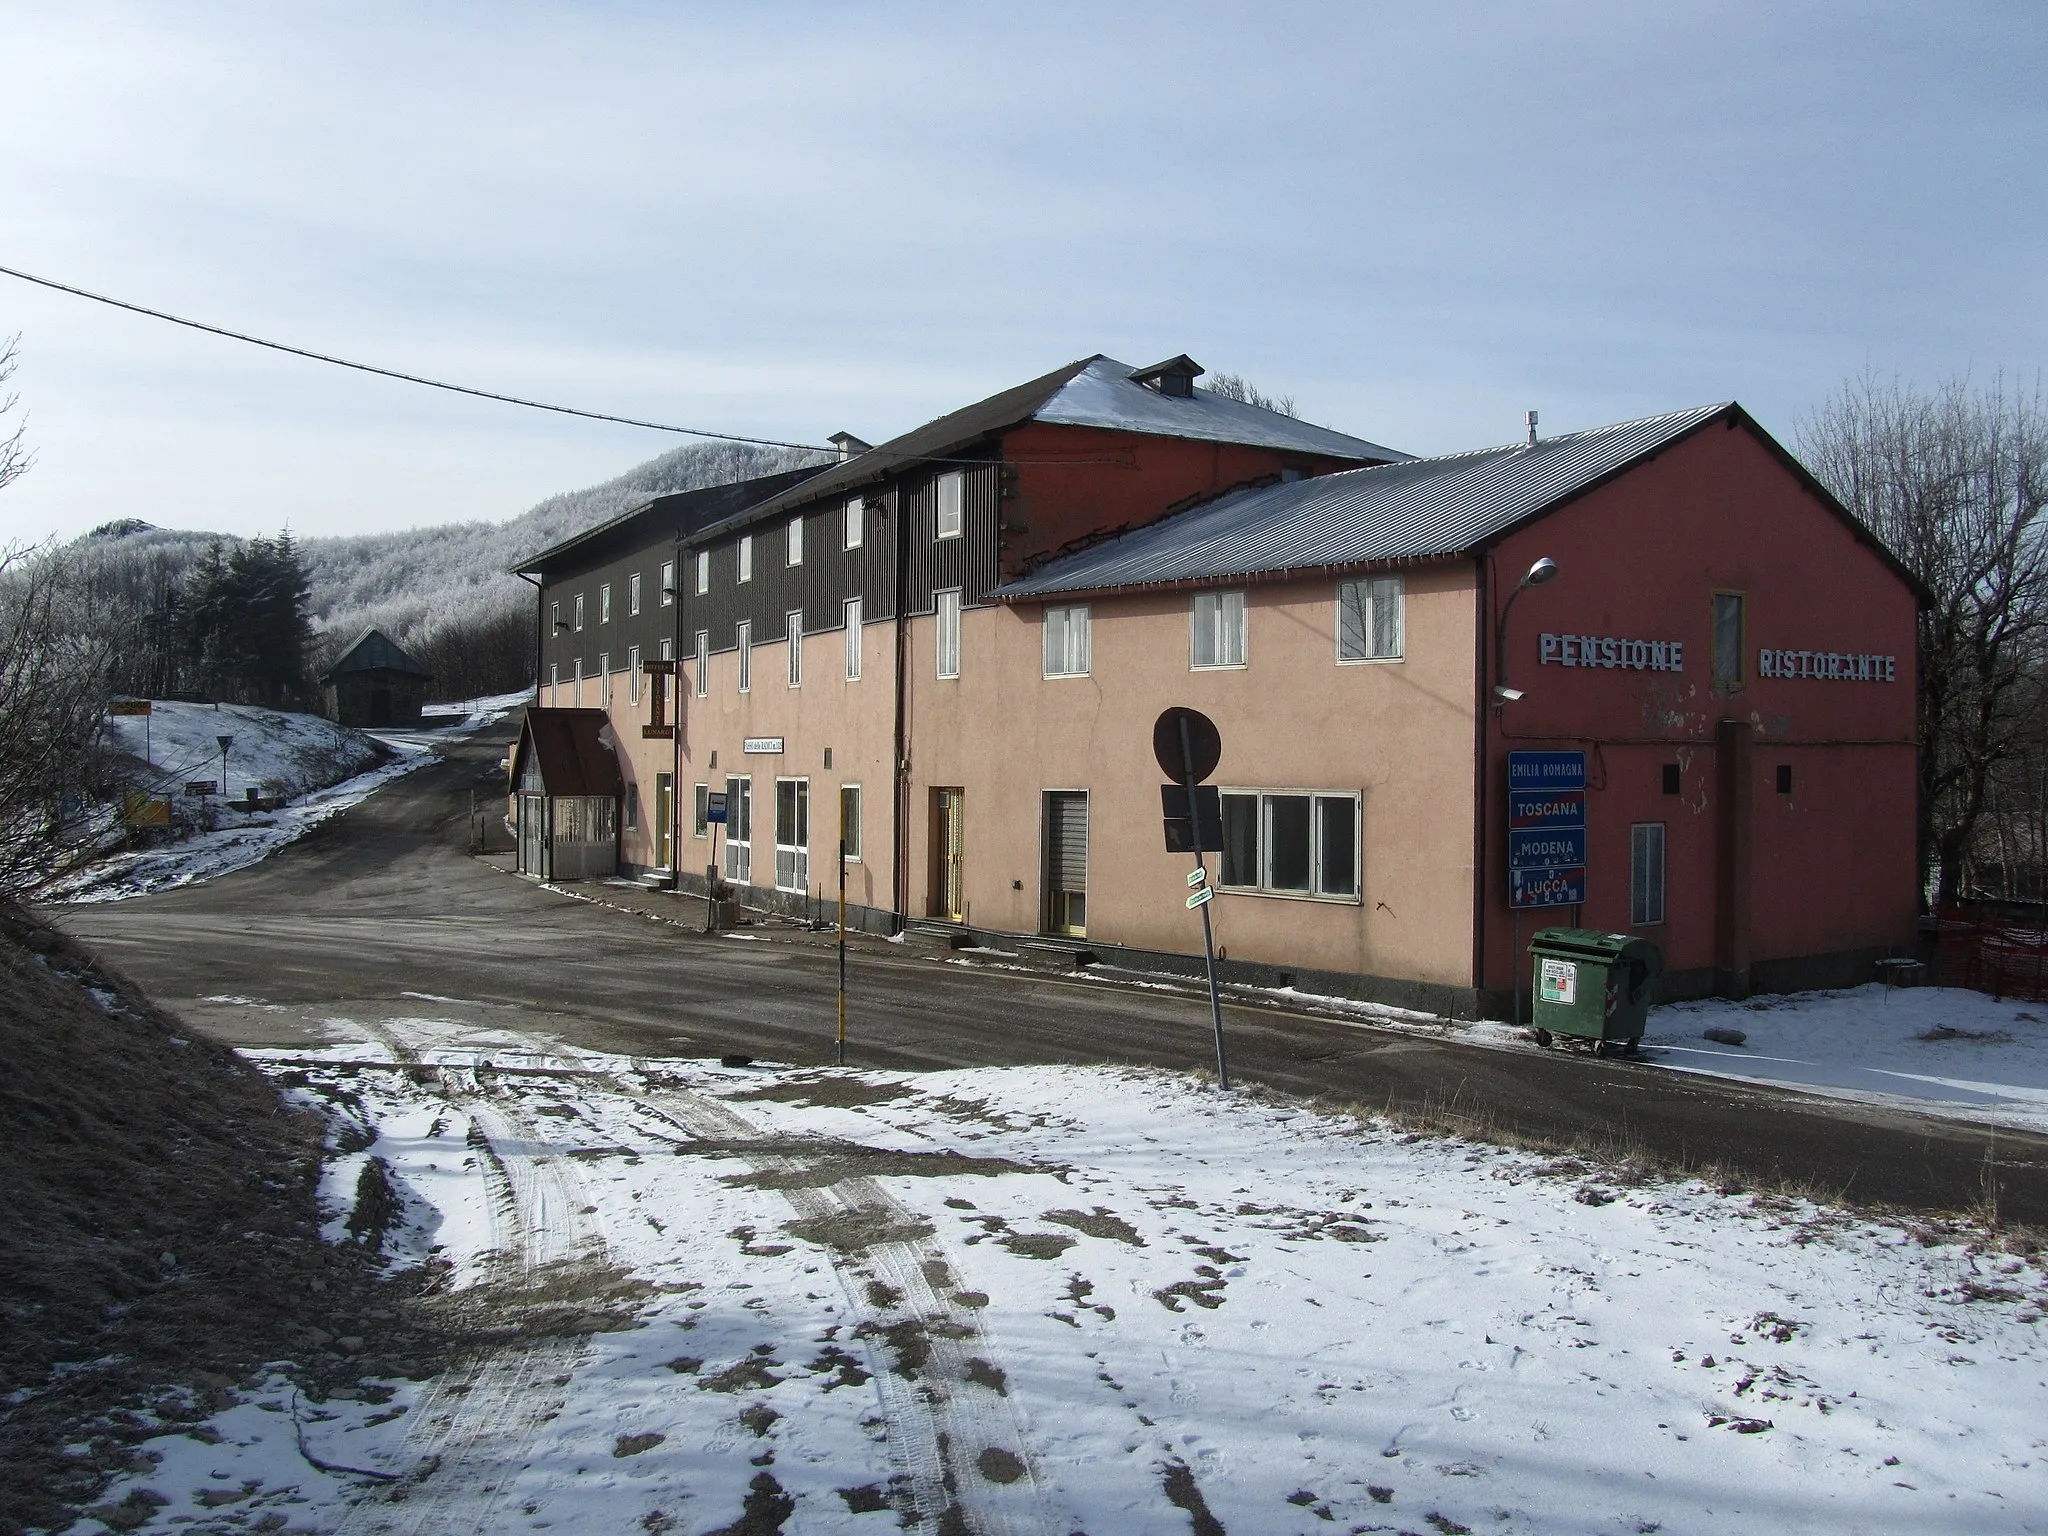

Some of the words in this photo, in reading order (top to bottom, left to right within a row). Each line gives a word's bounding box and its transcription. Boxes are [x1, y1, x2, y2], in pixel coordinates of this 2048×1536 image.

[1540, 633, 1683, 672] PENSIONE
[1760, 648, 1895, 682] RISTORANTE
[1512, 764, 1540, 777] EMILIA
[1543, 763, 1583, 777] ROMAGNA
[1518, 802, 1578, 817] TOSCANA
[1521, 841, 1574, 856] MODENA
[1527, 879, 1568, 894] LUCCA
